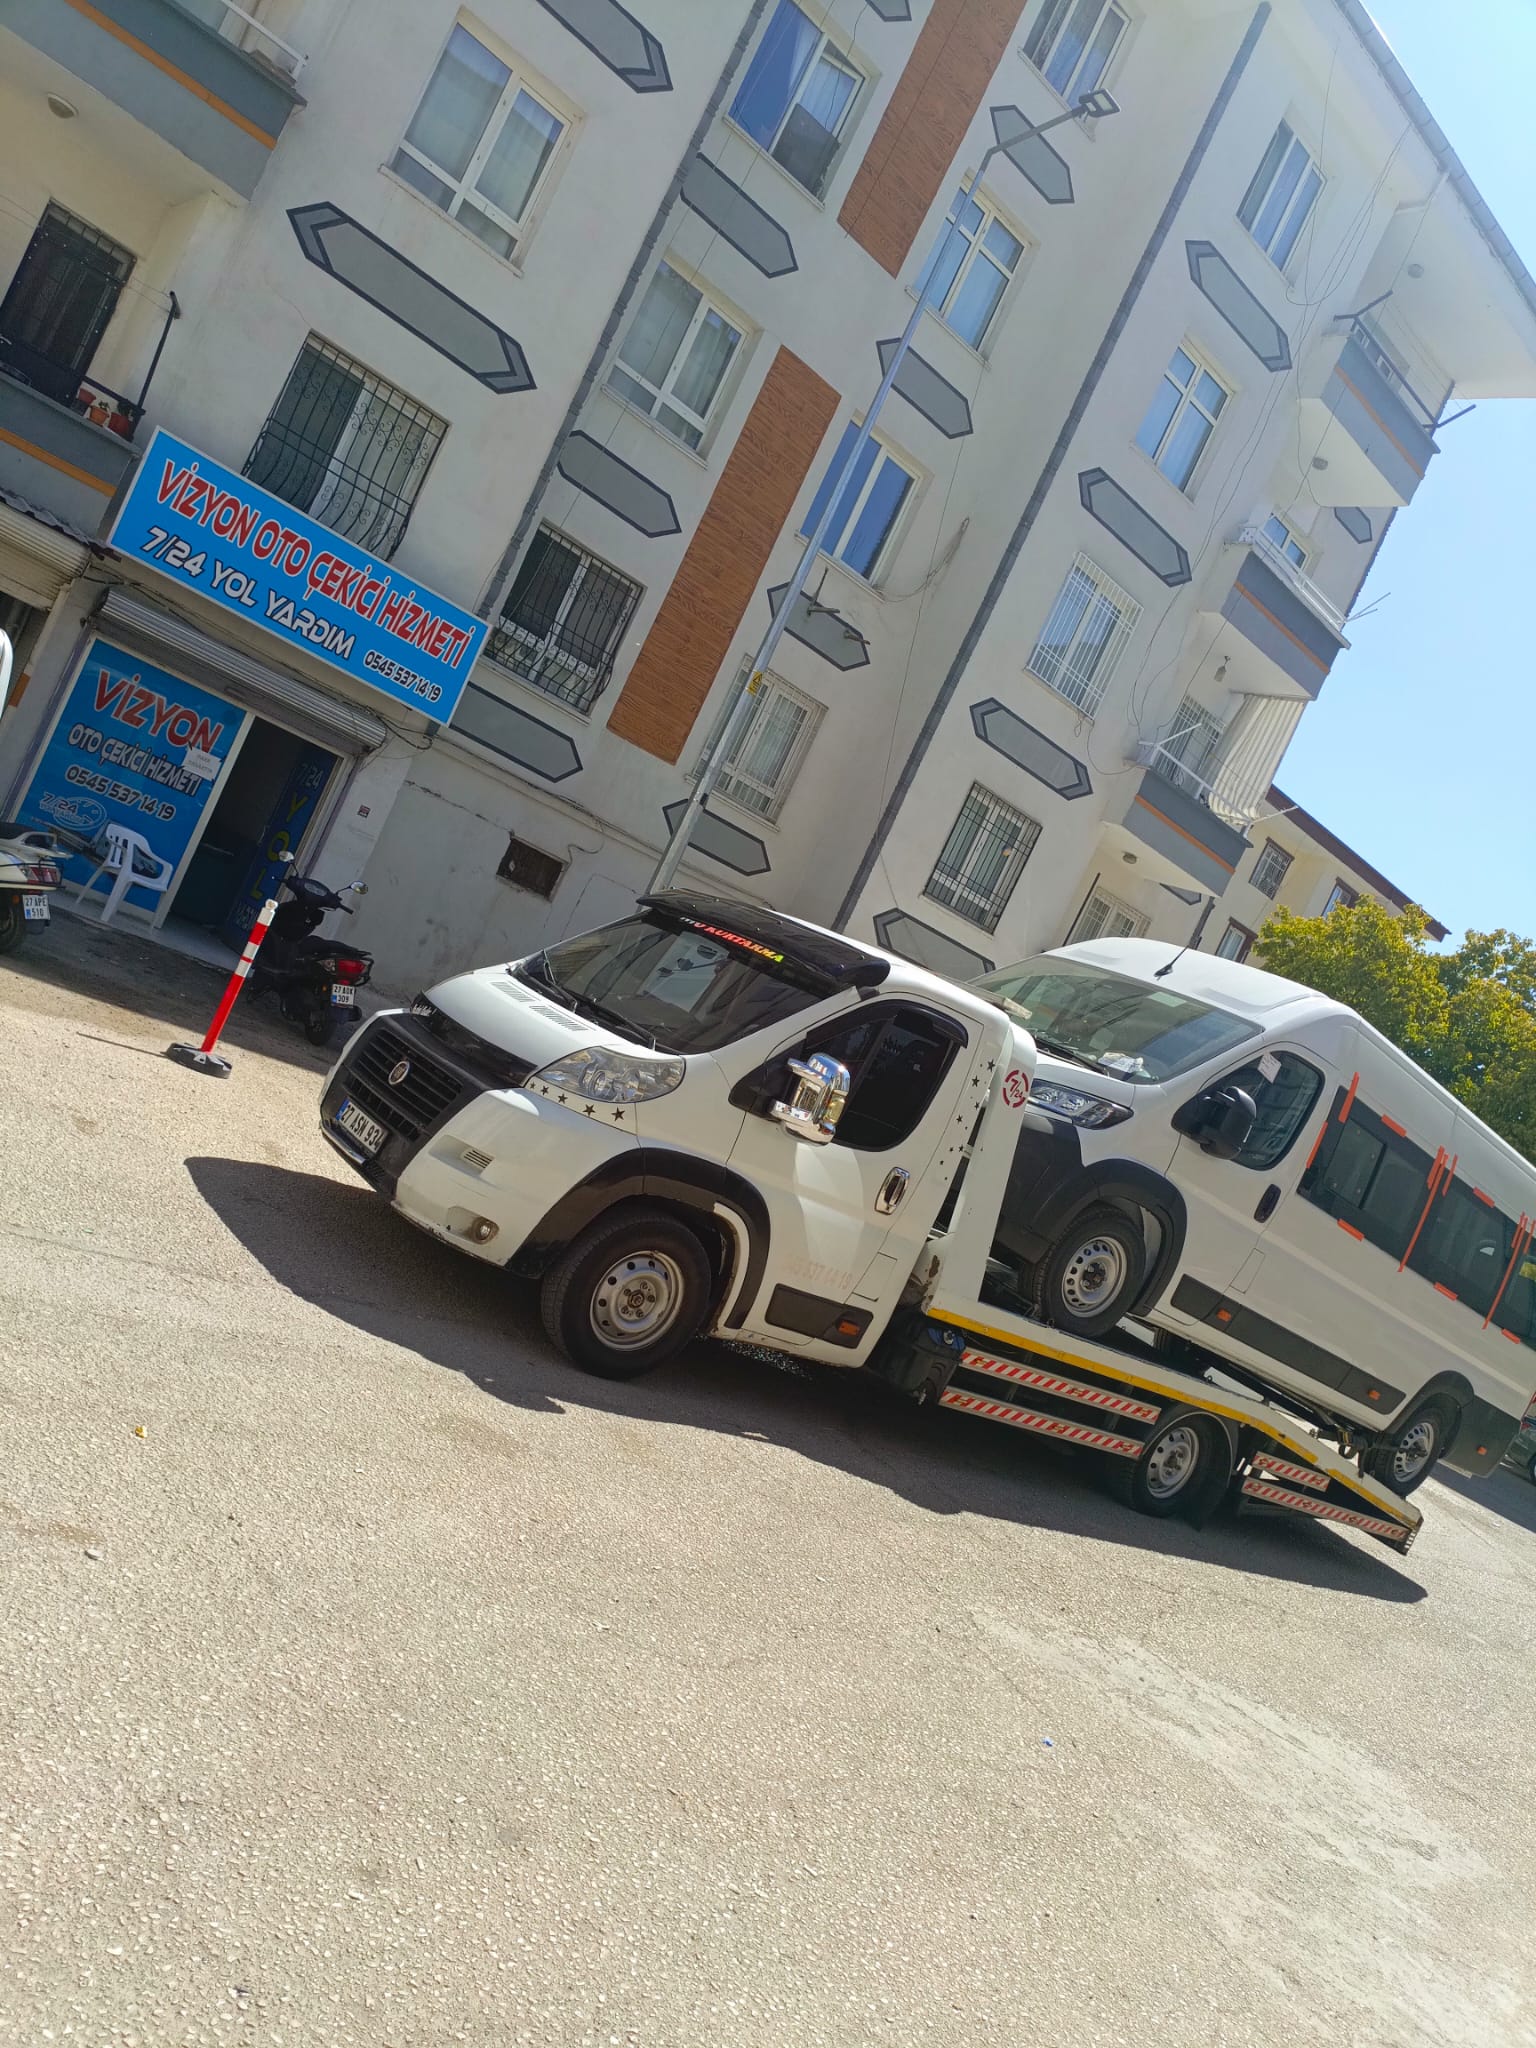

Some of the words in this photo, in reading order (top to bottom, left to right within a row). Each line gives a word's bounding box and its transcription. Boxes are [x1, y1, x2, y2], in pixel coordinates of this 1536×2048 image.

[156, 458, 259, 547] VİZYON
[252, 514, 312, 577] OTO
[304, 551, 390, 620] ÇEKİCİ
[377, 591, 476, 669] HİZMETİ
[141, 526, 207, 578] 7/24
[210, 560, 258, 608] YOL
[264, 589, 357, 660] YARDIM
[363, 650, 396, 678] 0545
[94, 669, 223, 753] VİZYON
[68, 723, 103, 753] OTO
[98, 742, 152, 774] ÇEKİCİ
[65, 764, 109, 795] 0545
[105, 781, 141, 806] 537
[138, 793, 158, 816] 14
[156, 800, 176, 822] 19
[25, 897, 34, 906] 27
[341, 1103, 352, 1124] 27
